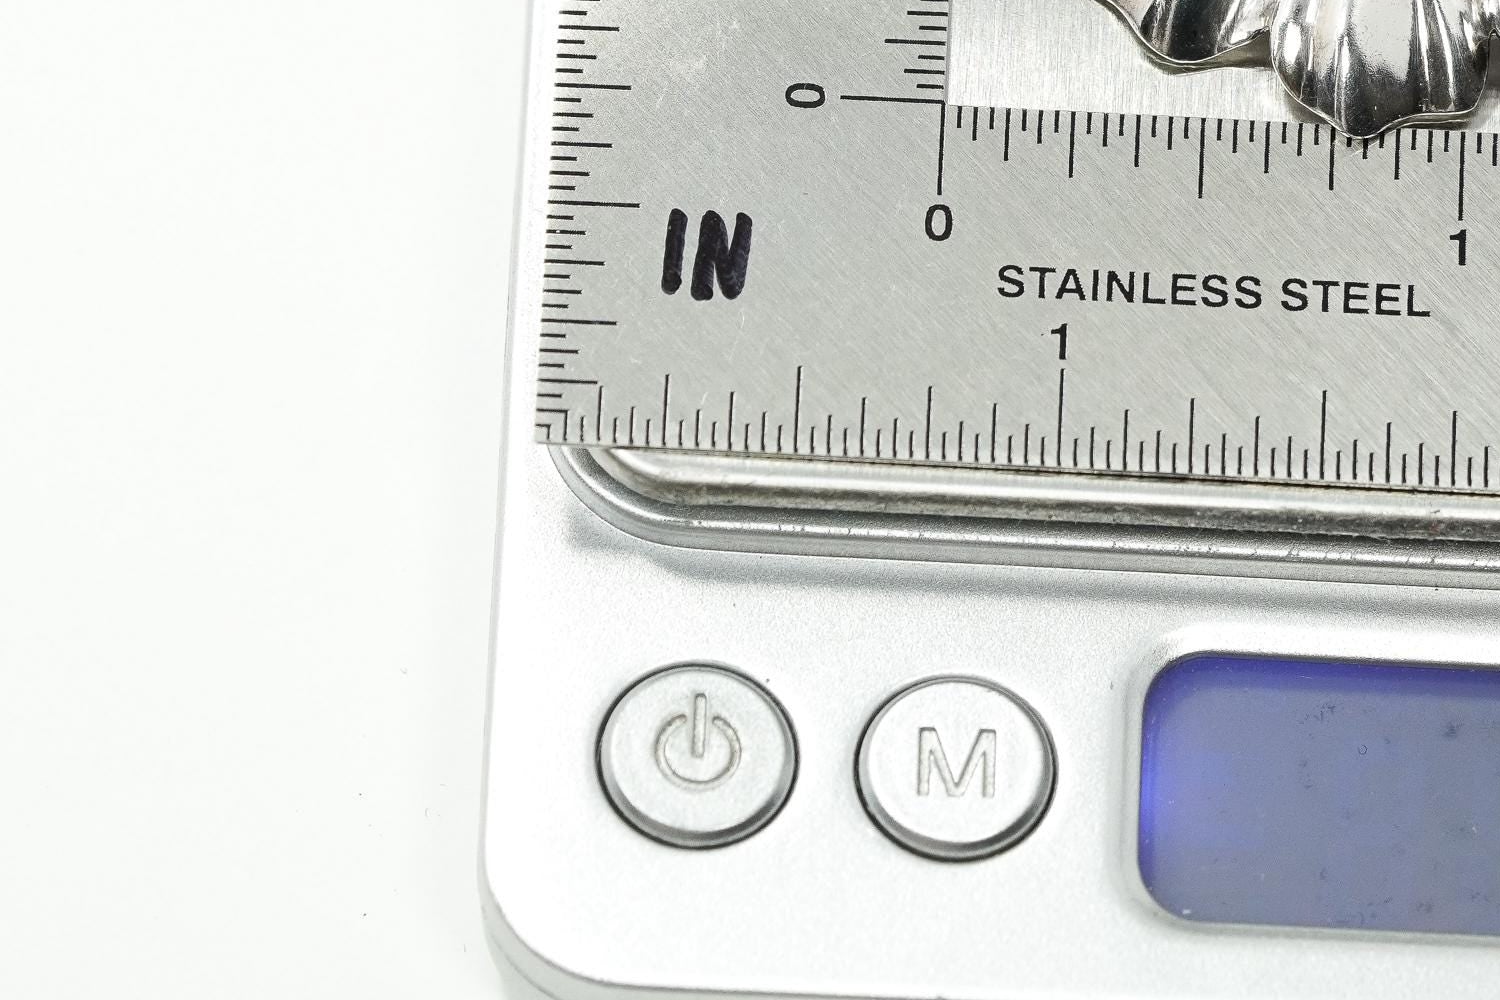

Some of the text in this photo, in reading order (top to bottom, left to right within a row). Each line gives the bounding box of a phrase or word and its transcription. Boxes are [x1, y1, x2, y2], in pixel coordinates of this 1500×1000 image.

[784, 82, 827, 109] 0
[924, 203, 954, 243] 0
[659, 206, 753, 302] IN
[1449, 227, 1469, 268] 1
[996, 263, 1433, 319] STAINLESS STEEL
[1050, 322, 1069, 362] 1
[915, 724, 998, 799] M
